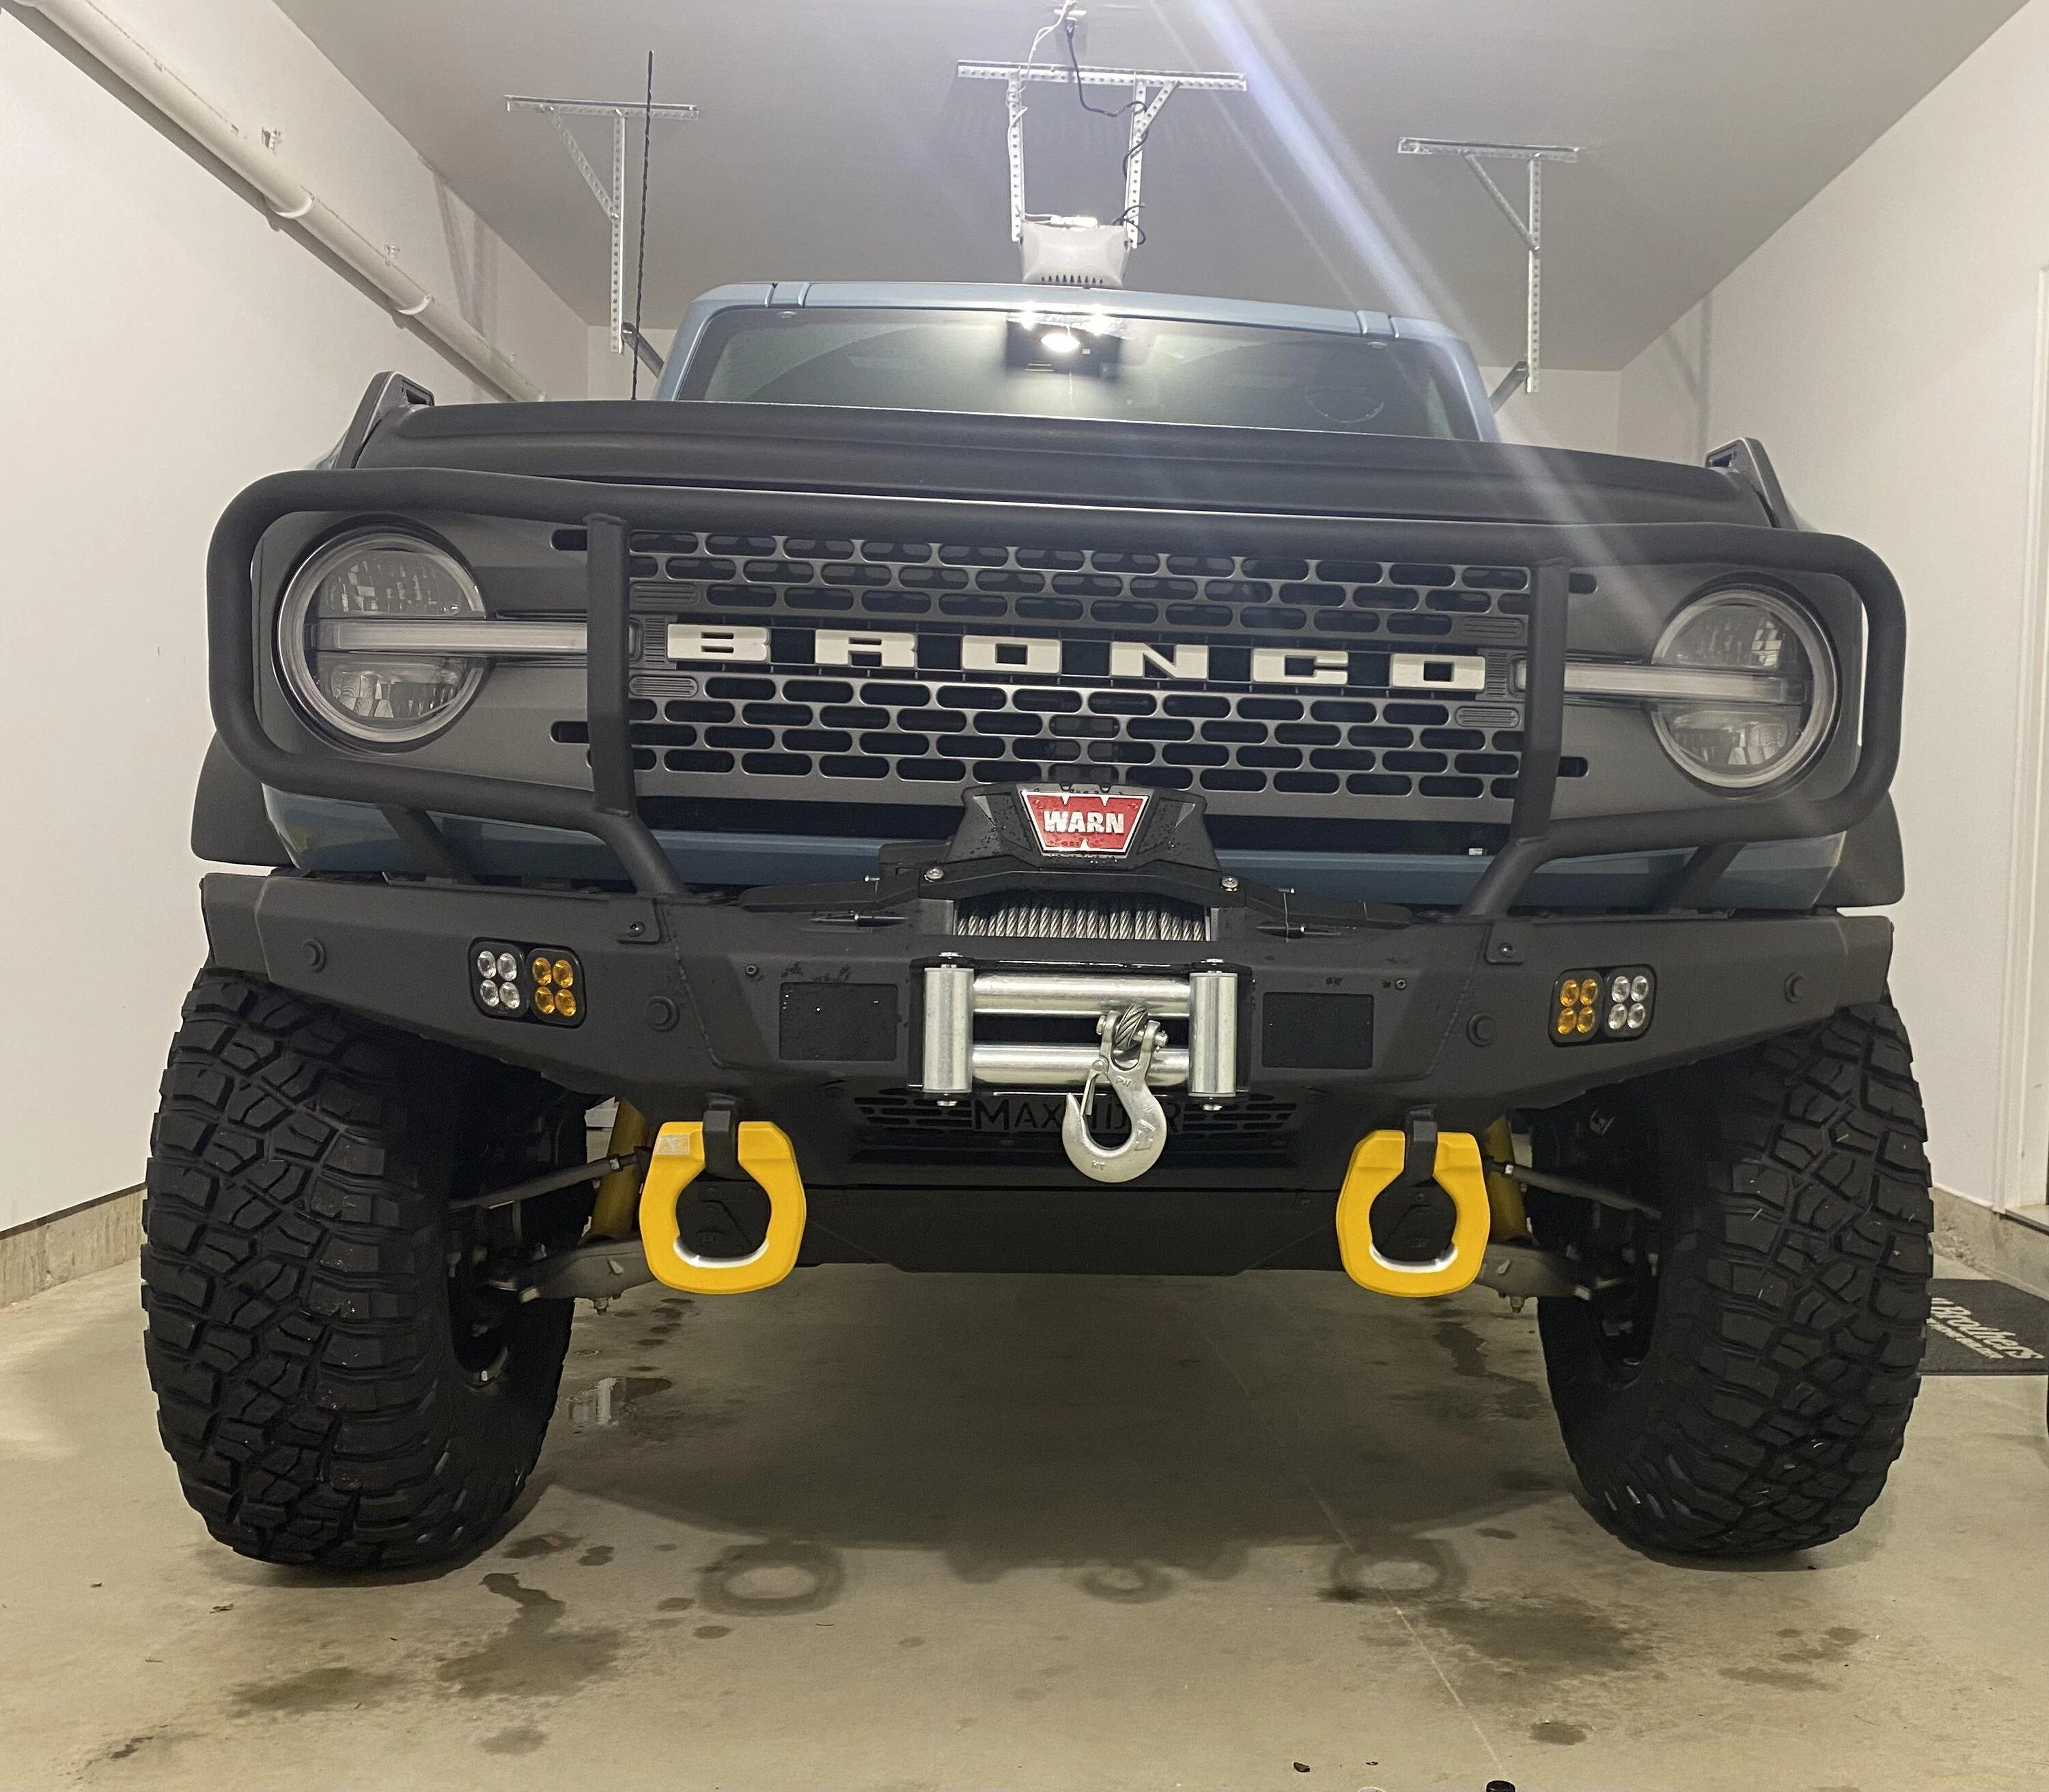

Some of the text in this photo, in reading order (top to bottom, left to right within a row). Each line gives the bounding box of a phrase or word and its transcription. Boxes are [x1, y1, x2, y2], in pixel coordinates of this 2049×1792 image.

[667, 623, 1486, 691] BRONCO
[1043, 810, 1125, 835] WARN
[975, 1098, 1181, 1134] MAXIDR
